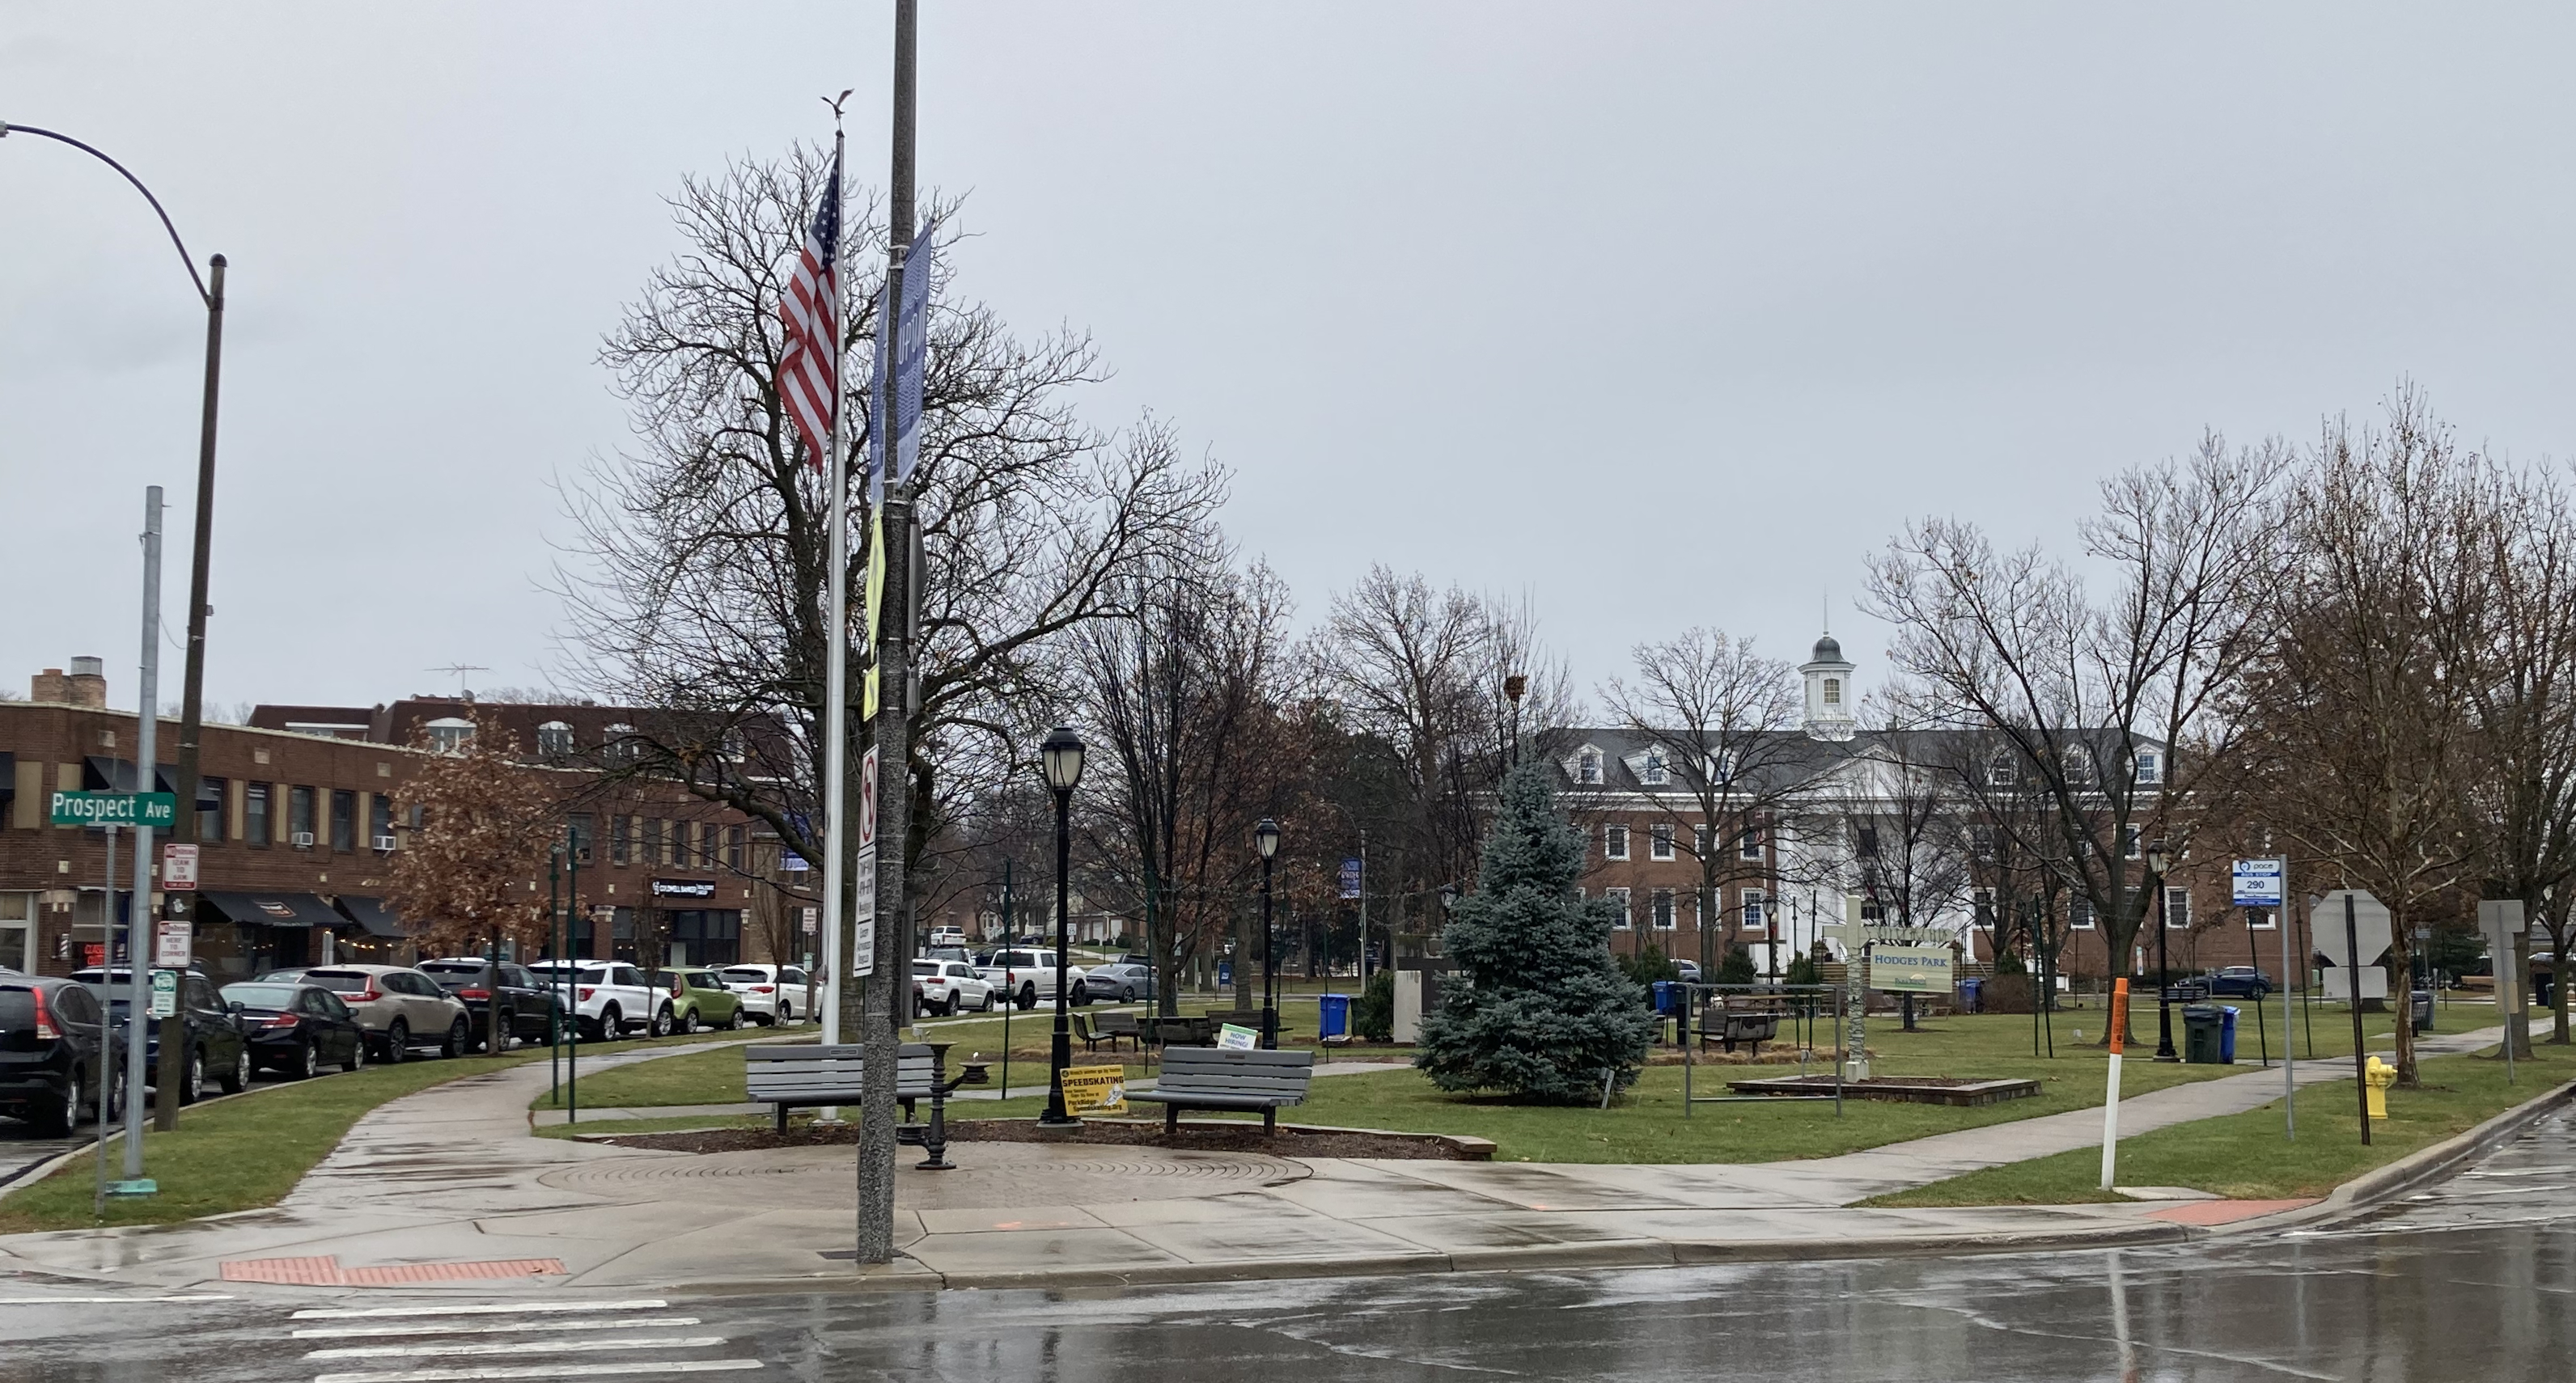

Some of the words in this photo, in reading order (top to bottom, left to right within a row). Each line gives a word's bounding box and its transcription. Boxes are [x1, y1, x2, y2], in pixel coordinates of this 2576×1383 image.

[52, 793, 136, 822] Prospect
[145, 801, 171, 818] Ave
[2247, 880, 2265, 889] 290
[1875, 954, 1918, 966] HODGES
[1921, 956, 1948, 967] PARK
[1230, 1032, 1247, 1040] NOW
[1225, 1038, 1248, 1048] HIRING!
[1062, 1076, 1124, 1087] SPEEDSKATING
